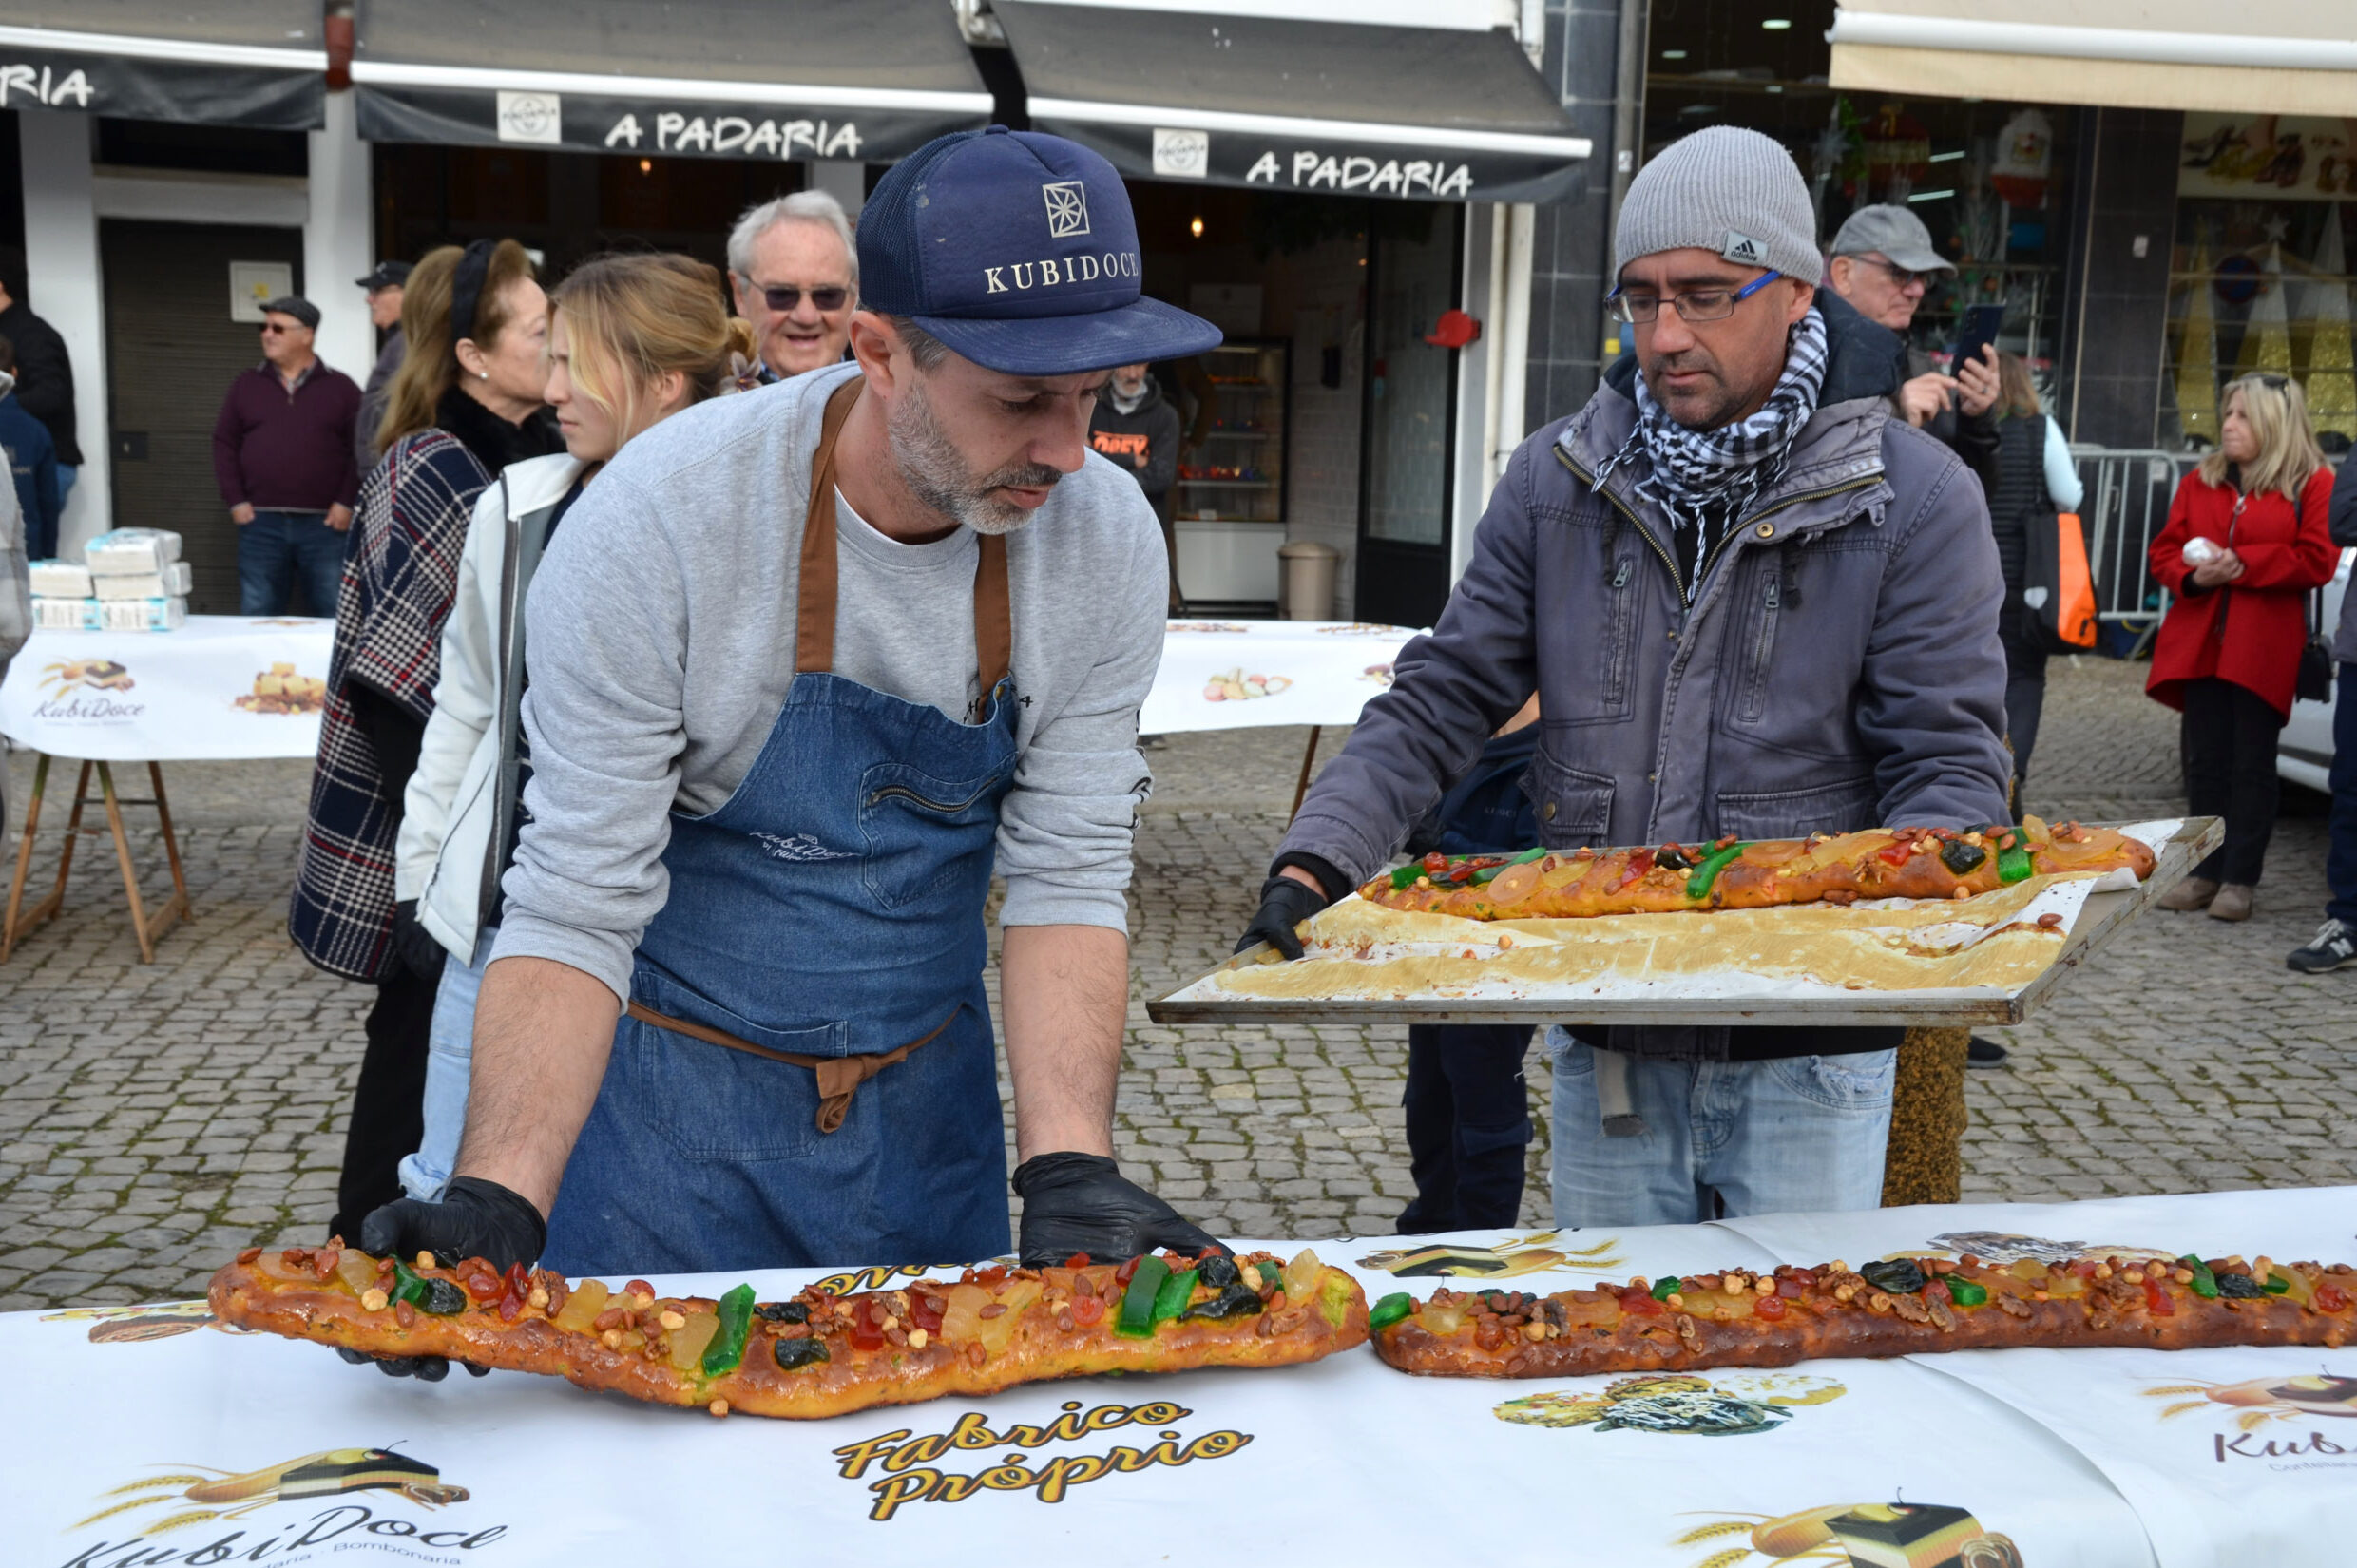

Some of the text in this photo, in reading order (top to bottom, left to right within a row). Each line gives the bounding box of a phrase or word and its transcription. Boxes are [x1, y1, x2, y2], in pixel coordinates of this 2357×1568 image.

[0, 64, 94, 107] RIA
[604, 113, 643, 148] A
[657, 112, 863, 161] PADARIA
[1245, 150, 1474, 199] A PADARIA
[984, 252, 1139, 294] KUBIDOCE
[832, 1401, 1193, 1479] Fabrico
[2214, 1431, 2357, 1462] Kub
[869, 1430, 1255, 1521] Próprio
[61, 1505, 508, 1568] KubiDoce
[333, 1541, 461, 1565] Bombonaria
